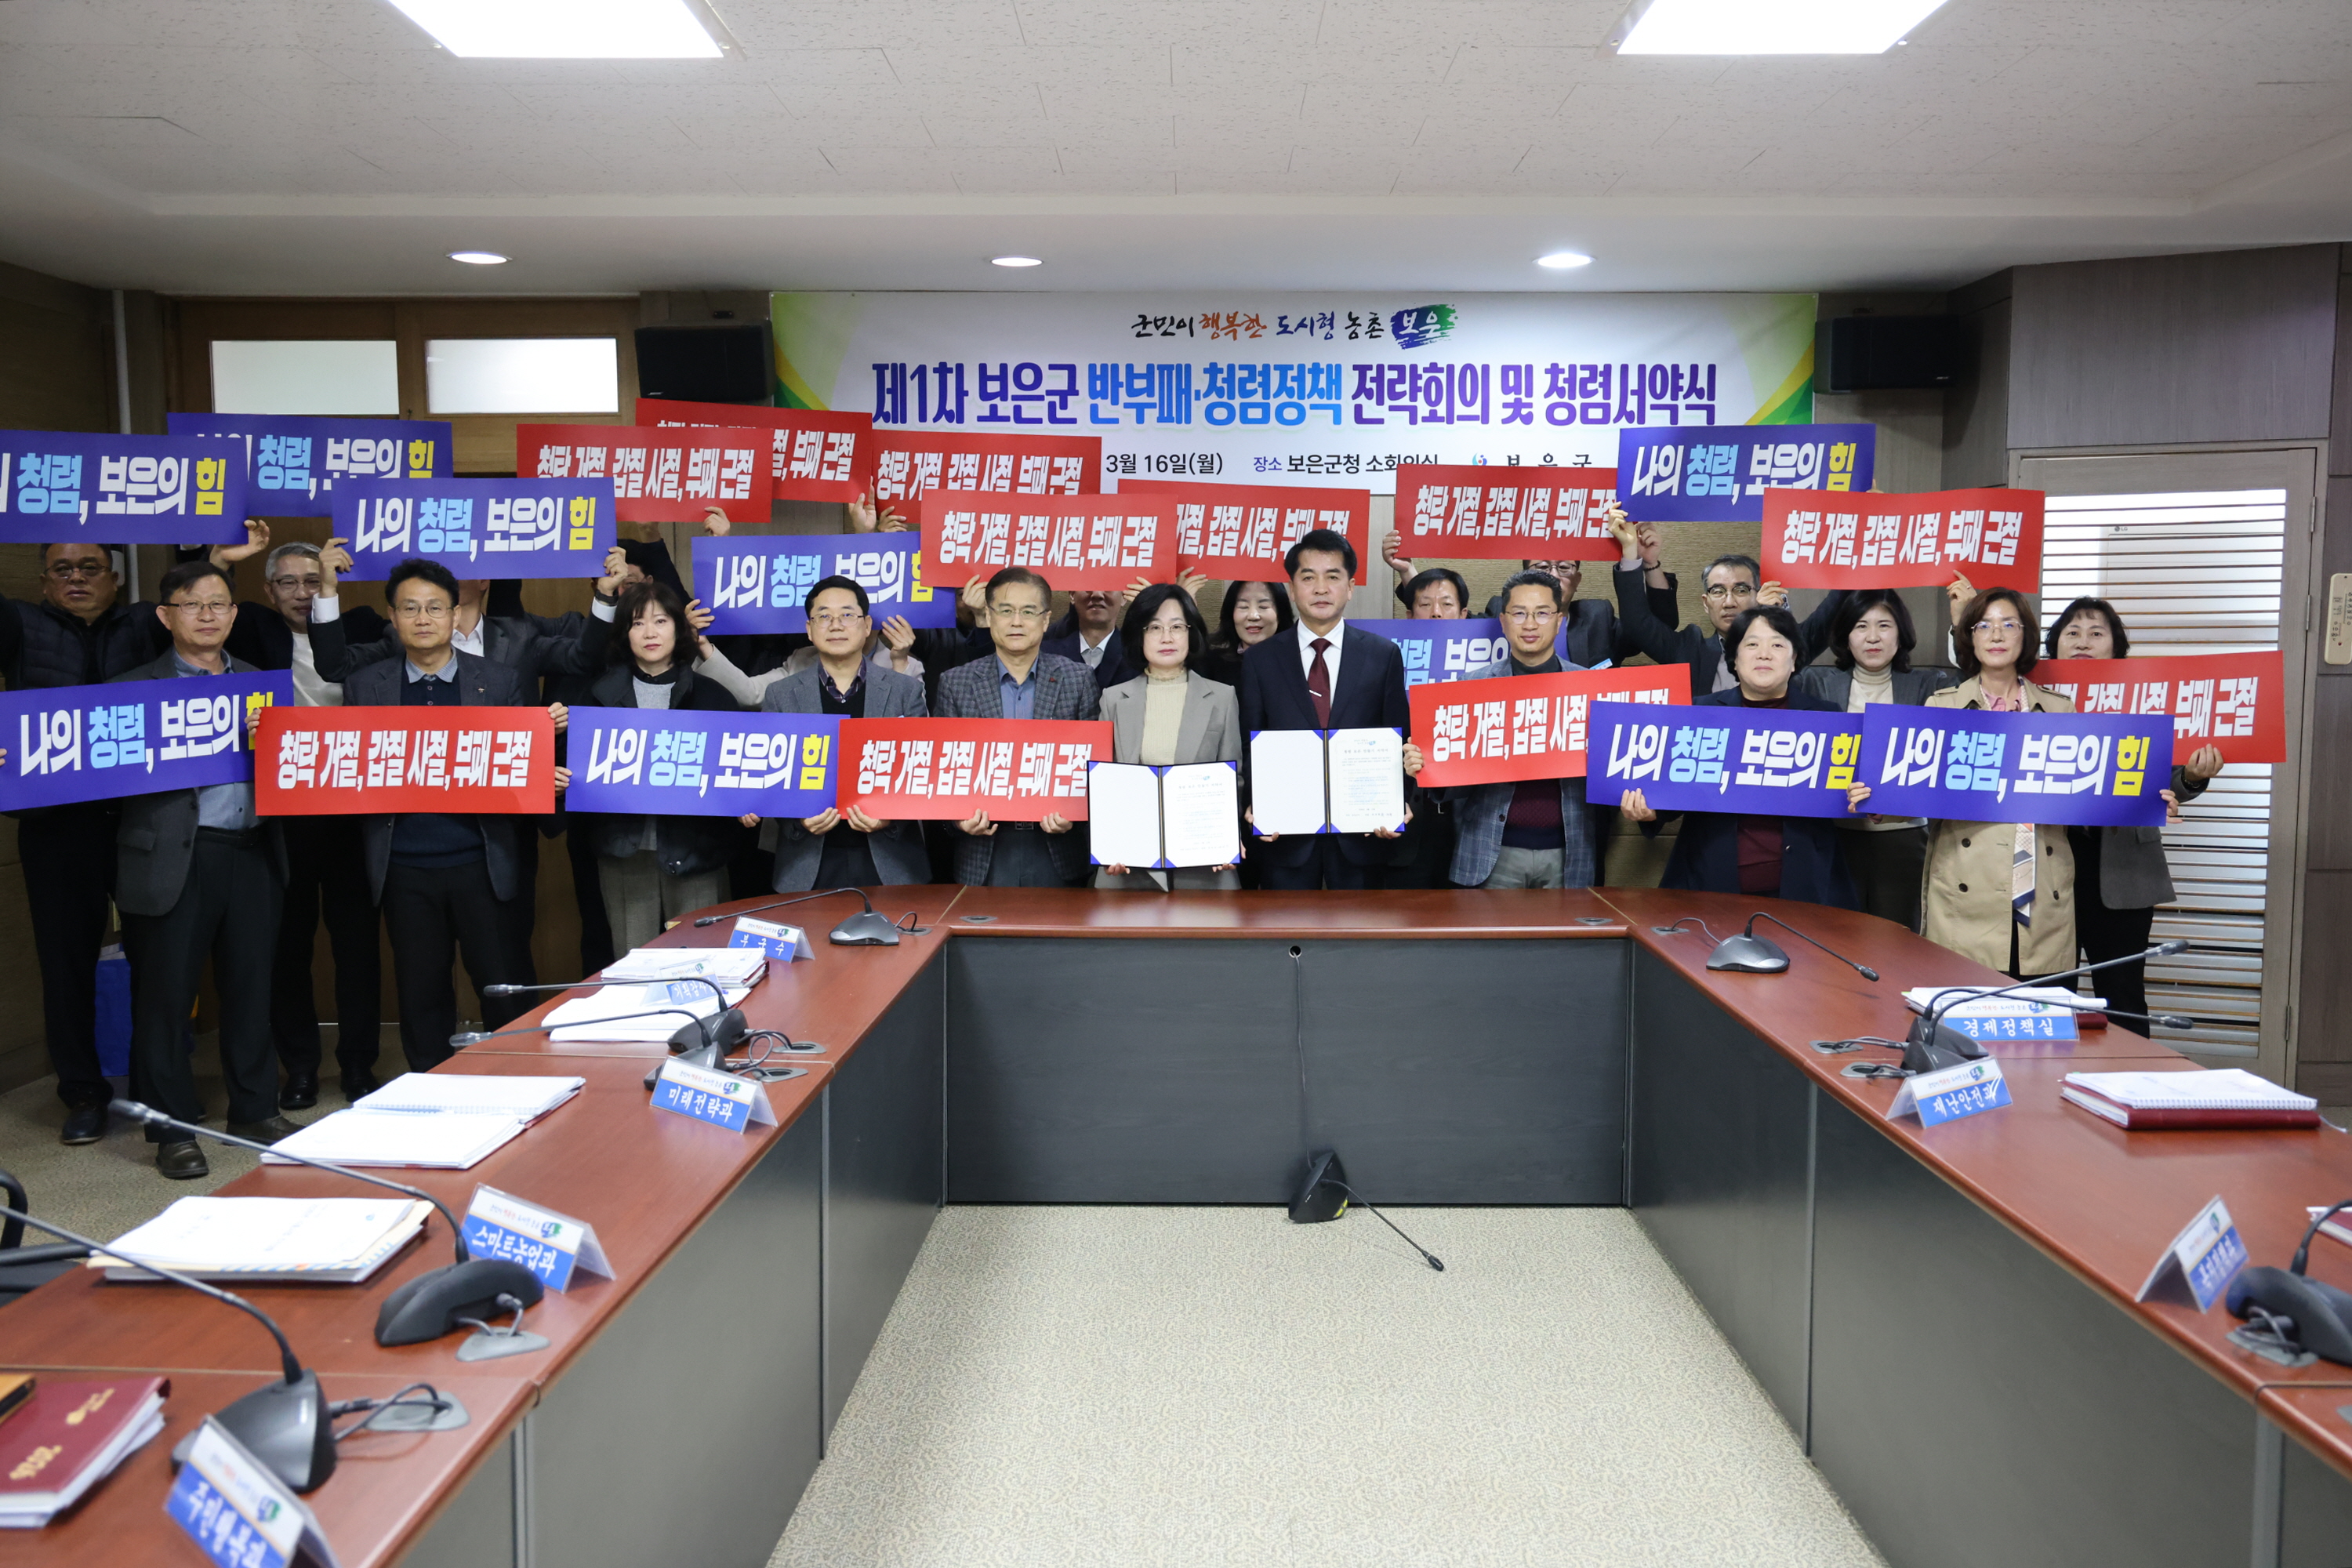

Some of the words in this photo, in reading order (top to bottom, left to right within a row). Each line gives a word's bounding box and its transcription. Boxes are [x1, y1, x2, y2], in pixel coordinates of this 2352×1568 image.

[1131, 314, 1194, 338] 군민이
[1198, 311, 1267, 341] 행복한
[1276, 311, 1335, 340] 도시형
[1344, 312, 1385, 340] 농촌
[872, 362, 969, 425] 제1차
[977, 362, 1079, 425] 보은군
[1352, 361, 1490, 426] 전략회의
[1501, 364, 1534, 426] 및
[1543, 361, 1716, 426] 청렴서약식
[257, 434, 317, 501] 청렴,
[612, 447, 647, 499] 갑질
[644, 448, 684, 503] 사절,
[685, 448, 720, 499] 부패
[719, 449, 755, 499] 근절
[789, 429, 825, 479] 부패
[819, 431, 856, 481] 근절
[877, 450, 910, 501] 청탁
[1105, 453, 1138, 474] 3월
[1144, 452, 1224, 474] 16일(월)
[1253, 456, 1282, 471] 장소
[1287, 453, 1360, 474] 보은군청
[1630, 444, 1685, 496] 나의
[1686, 444, 1740, 506] 청렴,
[1744, 442, 1825, 495] 보은의
[1826, 441, 1857, 492] 힘
[16, 452, 89, 526] 청렴,
[96, 456, 189, 515] 보은의
[195, 457, 227, 515] 힘
[1414, 485, 1449, 536] 청탁
[1446, 486, 1483, 540] 거절,
[1483, 487, 1519, 537] 갑질
[1515, 487, 1552, 541] 사절,
[1552, 488, 1588, 539] 부패
[355, 497, 413, 554] 나의
[418, 497, 478, 563] 청렴,
[484, 497, 564, 553] 보은의
[569, 496, 597, 550] 힘
[939, 510, 977, 564] 청탁
[975, 513, 1011, 568] 거절,
[1012, 514, 1051, 567] 갑질
[1047, 515, 1085, 571] 사절,
[1087, 515, 1123, 568] 부패
[1120, 516, 1158, 568] 근절
[1206, 505, 1244, 557] 갑질
[1240, 507, 1279, 563] 사절,
[1780, 510, 1821, 564] 청탁
[1819, 512, 1859, 570] 거절,
[1860, 514, 1902, 567] 갑질
[1899, 512, 1942, 567] 사절,
[1944, 510, 1985, 563] 부패
[1981, 510, 2024, 566] 근절
[713, 554, 767, 608] 나의
[20, 709, 82, 777] 나의
[88, 703, 154, 775] 청렴,
[161, 695, 240, 761] 보은의
[1433, 704, 1469, 762] 청탁
[1470, 700, 1510, 761] 거절,
[1512, 697, 1548, 756] 갑질
[2173, 679, 2215, 739] 부패
[2213, 677, 2259, 736] 근절
[278, 730, 320, 789] 청탁
[319, 730, 364, 792] 거절,
[366, 730, 408, 787] 갑질
[406, 730, 451, 792] 사절,
[452, 730, 493, 788] 부패
[491, 730, 532, 788] 근절
[586, 728, 648, 785] 나의
[648, 730, 709, 798] 청렴,
[713, 732, 797, 789] 보은의
[799, 734, 830, 790] 힘
[857, 740, 896, 794] 청탁
[895, 740, 934, 800] 거절,
[935, 741, 976, 796] 갑질
[973, 742, 1014, 800] 사절,
[1016, 742, 1055, 797] 부패
[1052, 743, 1092, 797] 근절
[1606, 724, 1669, 782] 나의
[1668, 725, 1730, 795] 청렴,
[1735, 728, 1827, 789] 보은의
[1825, 732, 1862, 789] 힘
[1880, 727, 1945, 788] 나의
[1945, 730, 2007, 804] 청렴,
[2013, 734, 2111, 796] 보은의
[2112, 735, 2151, 797] 힘
[1963, 1017, 2054, 1037] 경제정책실
[668, 1085, 734, 1123] 미래전략과
[1933, 1082, 1997, 1117] 재난안전과
[471, 1225, 557, 1279] 스마트농업과
